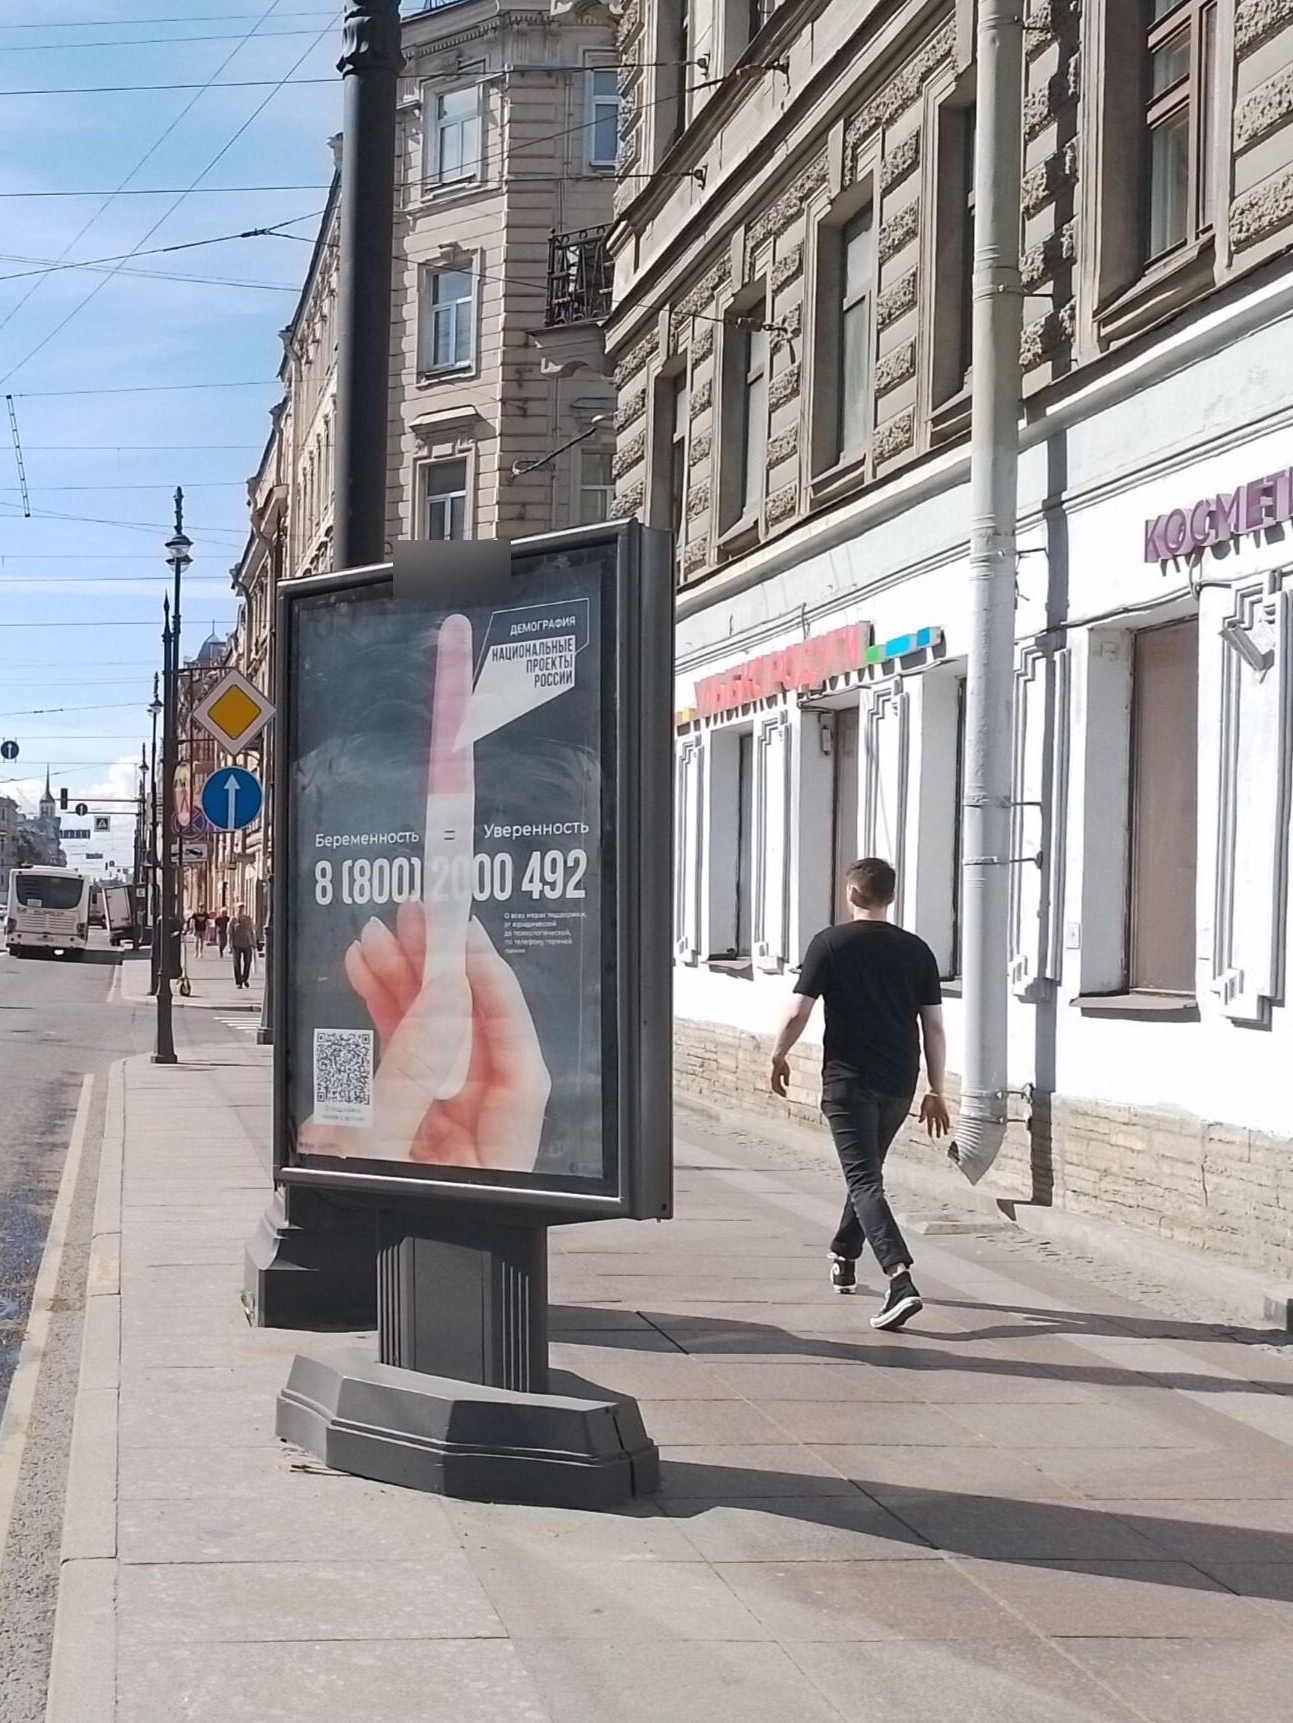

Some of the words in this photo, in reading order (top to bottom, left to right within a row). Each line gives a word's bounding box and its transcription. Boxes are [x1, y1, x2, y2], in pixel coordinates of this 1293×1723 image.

[1144, 466, 1293, 563] КОСМЕТ
[509, 616, 576, 637] ДЕМОГРАФИЯ
[491, 637, 573, 662] НАЦИОНАЛЬНЫЕ
[526, 653, 573, 674] ПРОЕКТЫ
[534, 670, 573, 688] РОССИИ
[315, 831, 420, 850] Беременность
[483, 821, 590, 840] Уверенность
[314, 860, 334, 906] 8
[341, 856, 423, 905] (800)
[520, 848, 588, 900] 492
